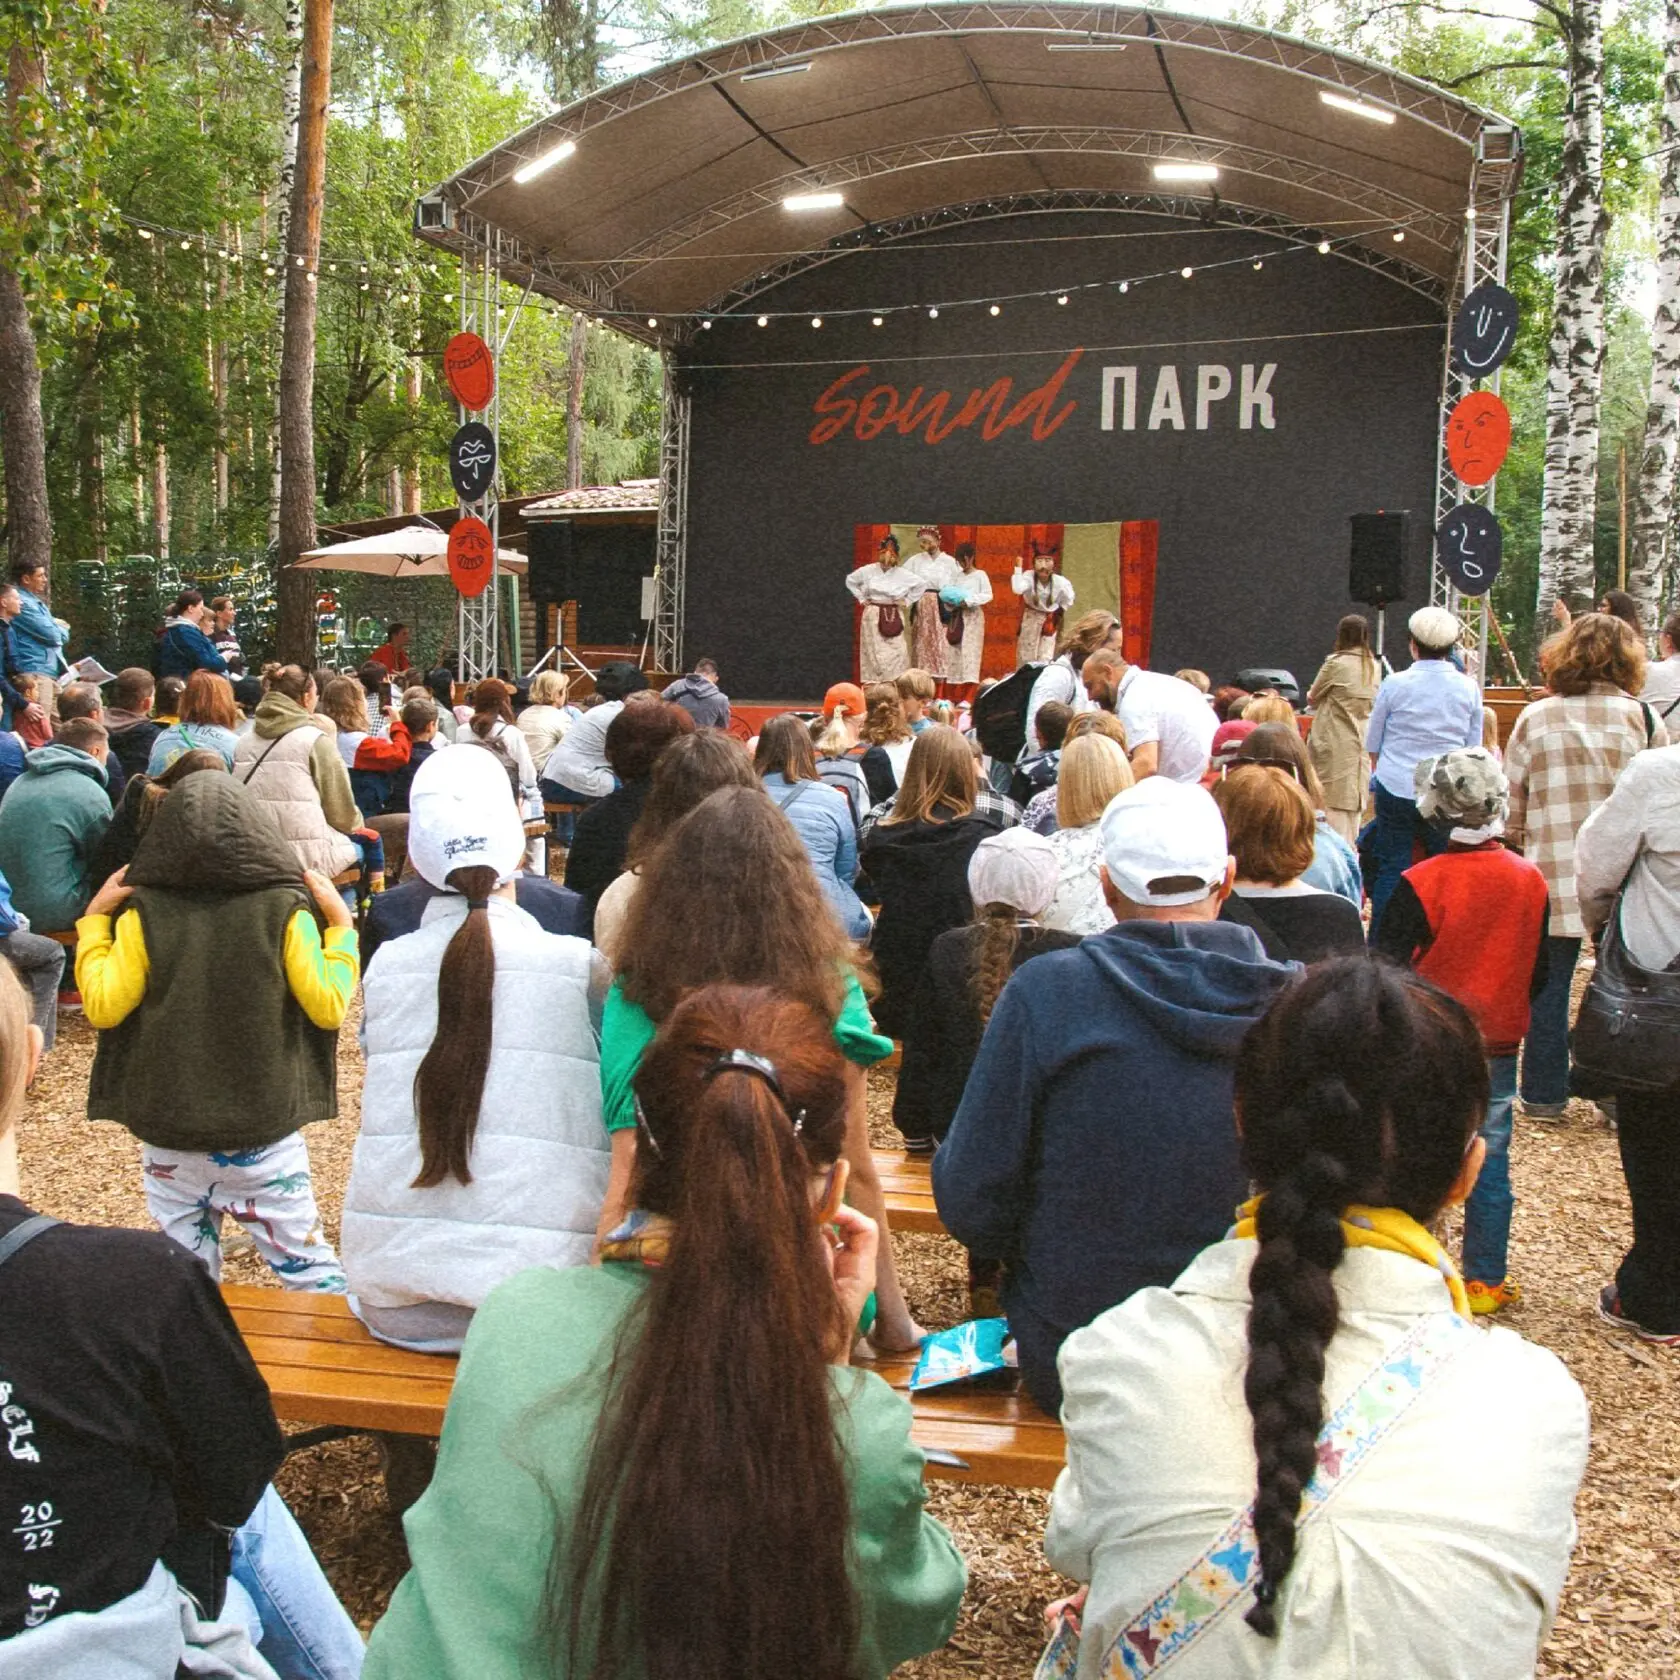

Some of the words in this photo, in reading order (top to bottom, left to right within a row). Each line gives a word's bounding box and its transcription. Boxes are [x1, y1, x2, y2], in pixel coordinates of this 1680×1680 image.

[1100, 363, 1278, 431] ПАРК
[20, 1500, 53, 1525] 20
[23, 1528, 54, 1551] 22
